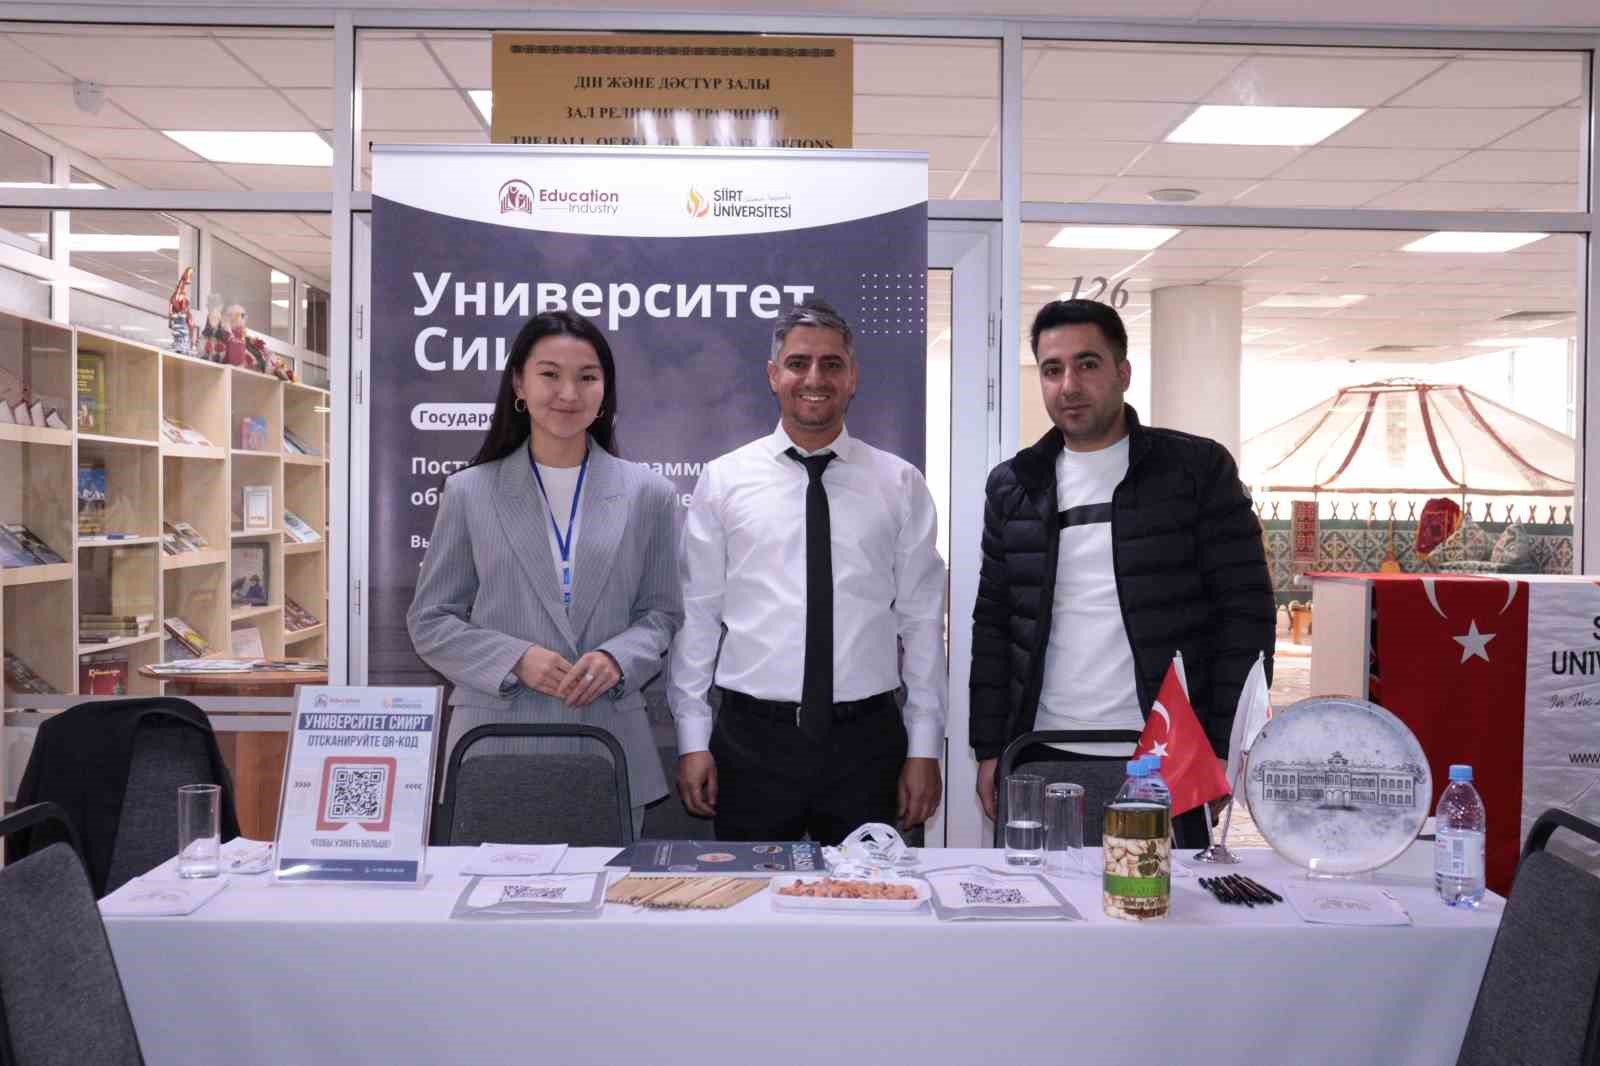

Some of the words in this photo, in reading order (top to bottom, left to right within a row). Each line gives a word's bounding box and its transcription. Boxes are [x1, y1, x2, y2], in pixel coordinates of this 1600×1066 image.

[607, 77, 655, 89] ЖӘНЕ
[727, 78, 770, 90] ЗАЛЫ
[566, 106, 594, 119] ЗАЛ
[539, 189, 619, 202] Education
[568, 202, 619, 215] Industry
[1071, 275, 1131, 309] 126
[1551, 651, 1600, 675] UNI
[304, 714, 388, 729] УНИВЕРСИТЕТ
[389, 715, 428, 730] СИИРТ
[307, 734, 380, 747] ОТСКАНИРУЙТЕ
